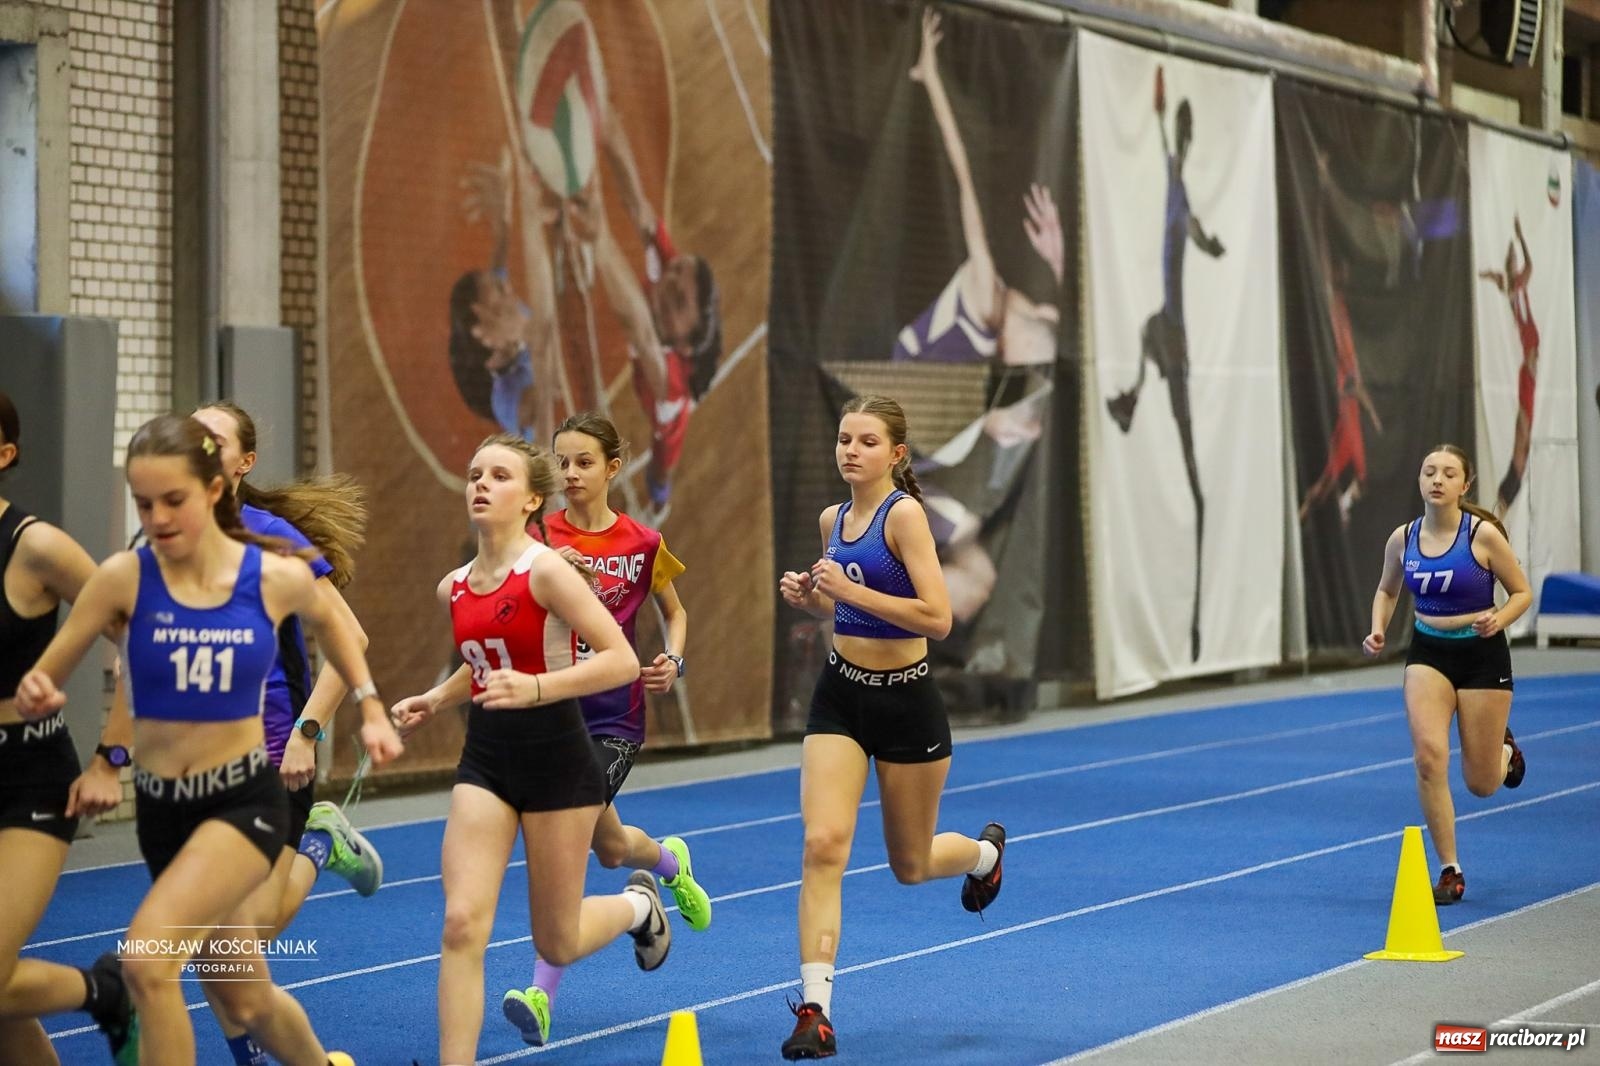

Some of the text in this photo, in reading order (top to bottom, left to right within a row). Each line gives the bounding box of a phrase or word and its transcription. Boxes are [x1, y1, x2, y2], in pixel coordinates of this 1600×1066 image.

[1413, 570, 1454, 595] 77
[169, 646, 234, 693] 141
[461, 638, 513, 688] 87
[839, 662, 929, 686] NIKE PRO
[174, 757, 247, 802] NIKE
